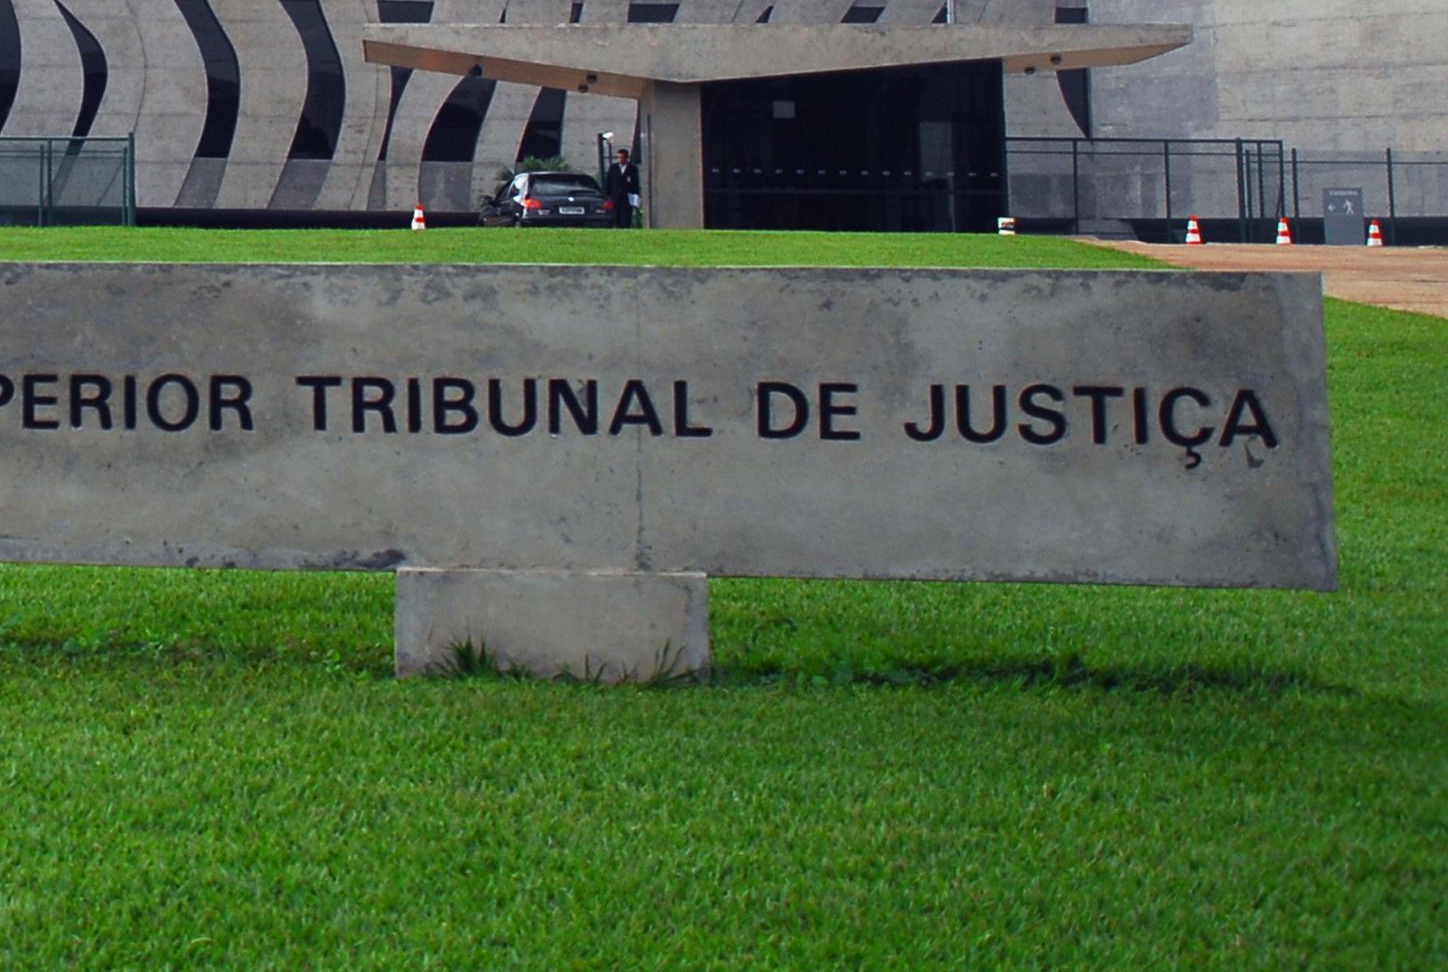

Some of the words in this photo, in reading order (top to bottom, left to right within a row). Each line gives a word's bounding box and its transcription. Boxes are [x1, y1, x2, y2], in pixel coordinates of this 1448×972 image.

[295, 375, 713, 438] TRIBUNAL
[756, 381, 861, 441] DE
[903, 383, 1279, 471] JUSTIÇA
